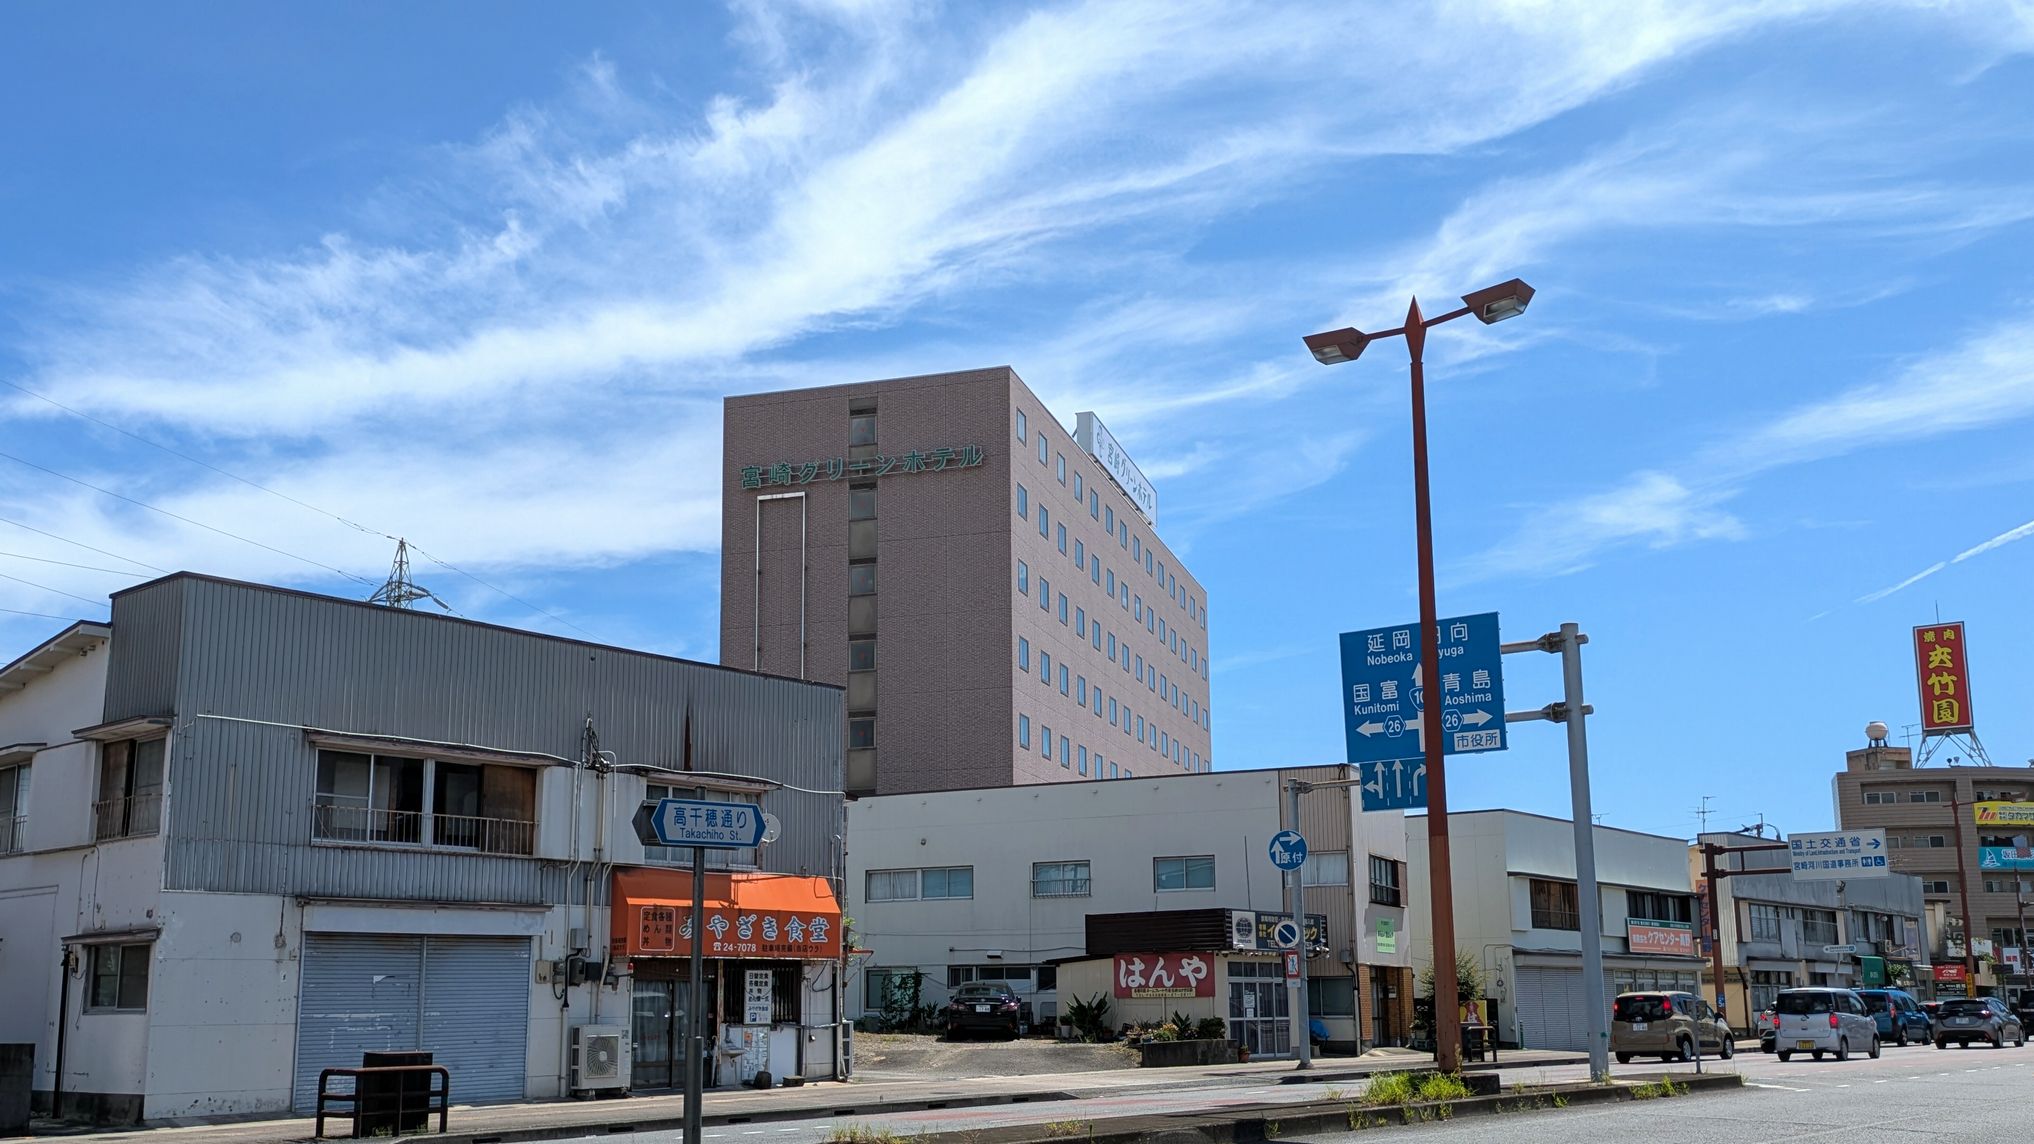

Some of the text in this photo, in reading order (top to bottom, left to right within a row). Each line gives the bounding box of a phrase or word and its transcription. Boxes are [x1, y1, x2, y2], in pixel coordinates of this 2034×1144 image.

[741, 444, 983, 490] 宮崎グリーンホテル
[1367, 629, 1411, 653] 延岡
[1367, 645, 1464, 666] Nobeoka yuga
[1353, 669, 1492, 703] 国富 青島
[1354, 692, 1492, 716] Kunitomi Aoshima
[1388, 720, 1401, 733] 26
[1445, 714, 1459, 727] 26
[1456, 732, 1498, 749] 市役所
[673, 807, 747, 829] 高千穂通り
[680, 828, 742, 841] Takachiho St.
[1791, 836, 1861, 850] 国土交通省
[1280, 851, 1303, 864] 原付
[723, 943, 757, 953] 24-7078
[1119, 956, 1208, 988] はんや
